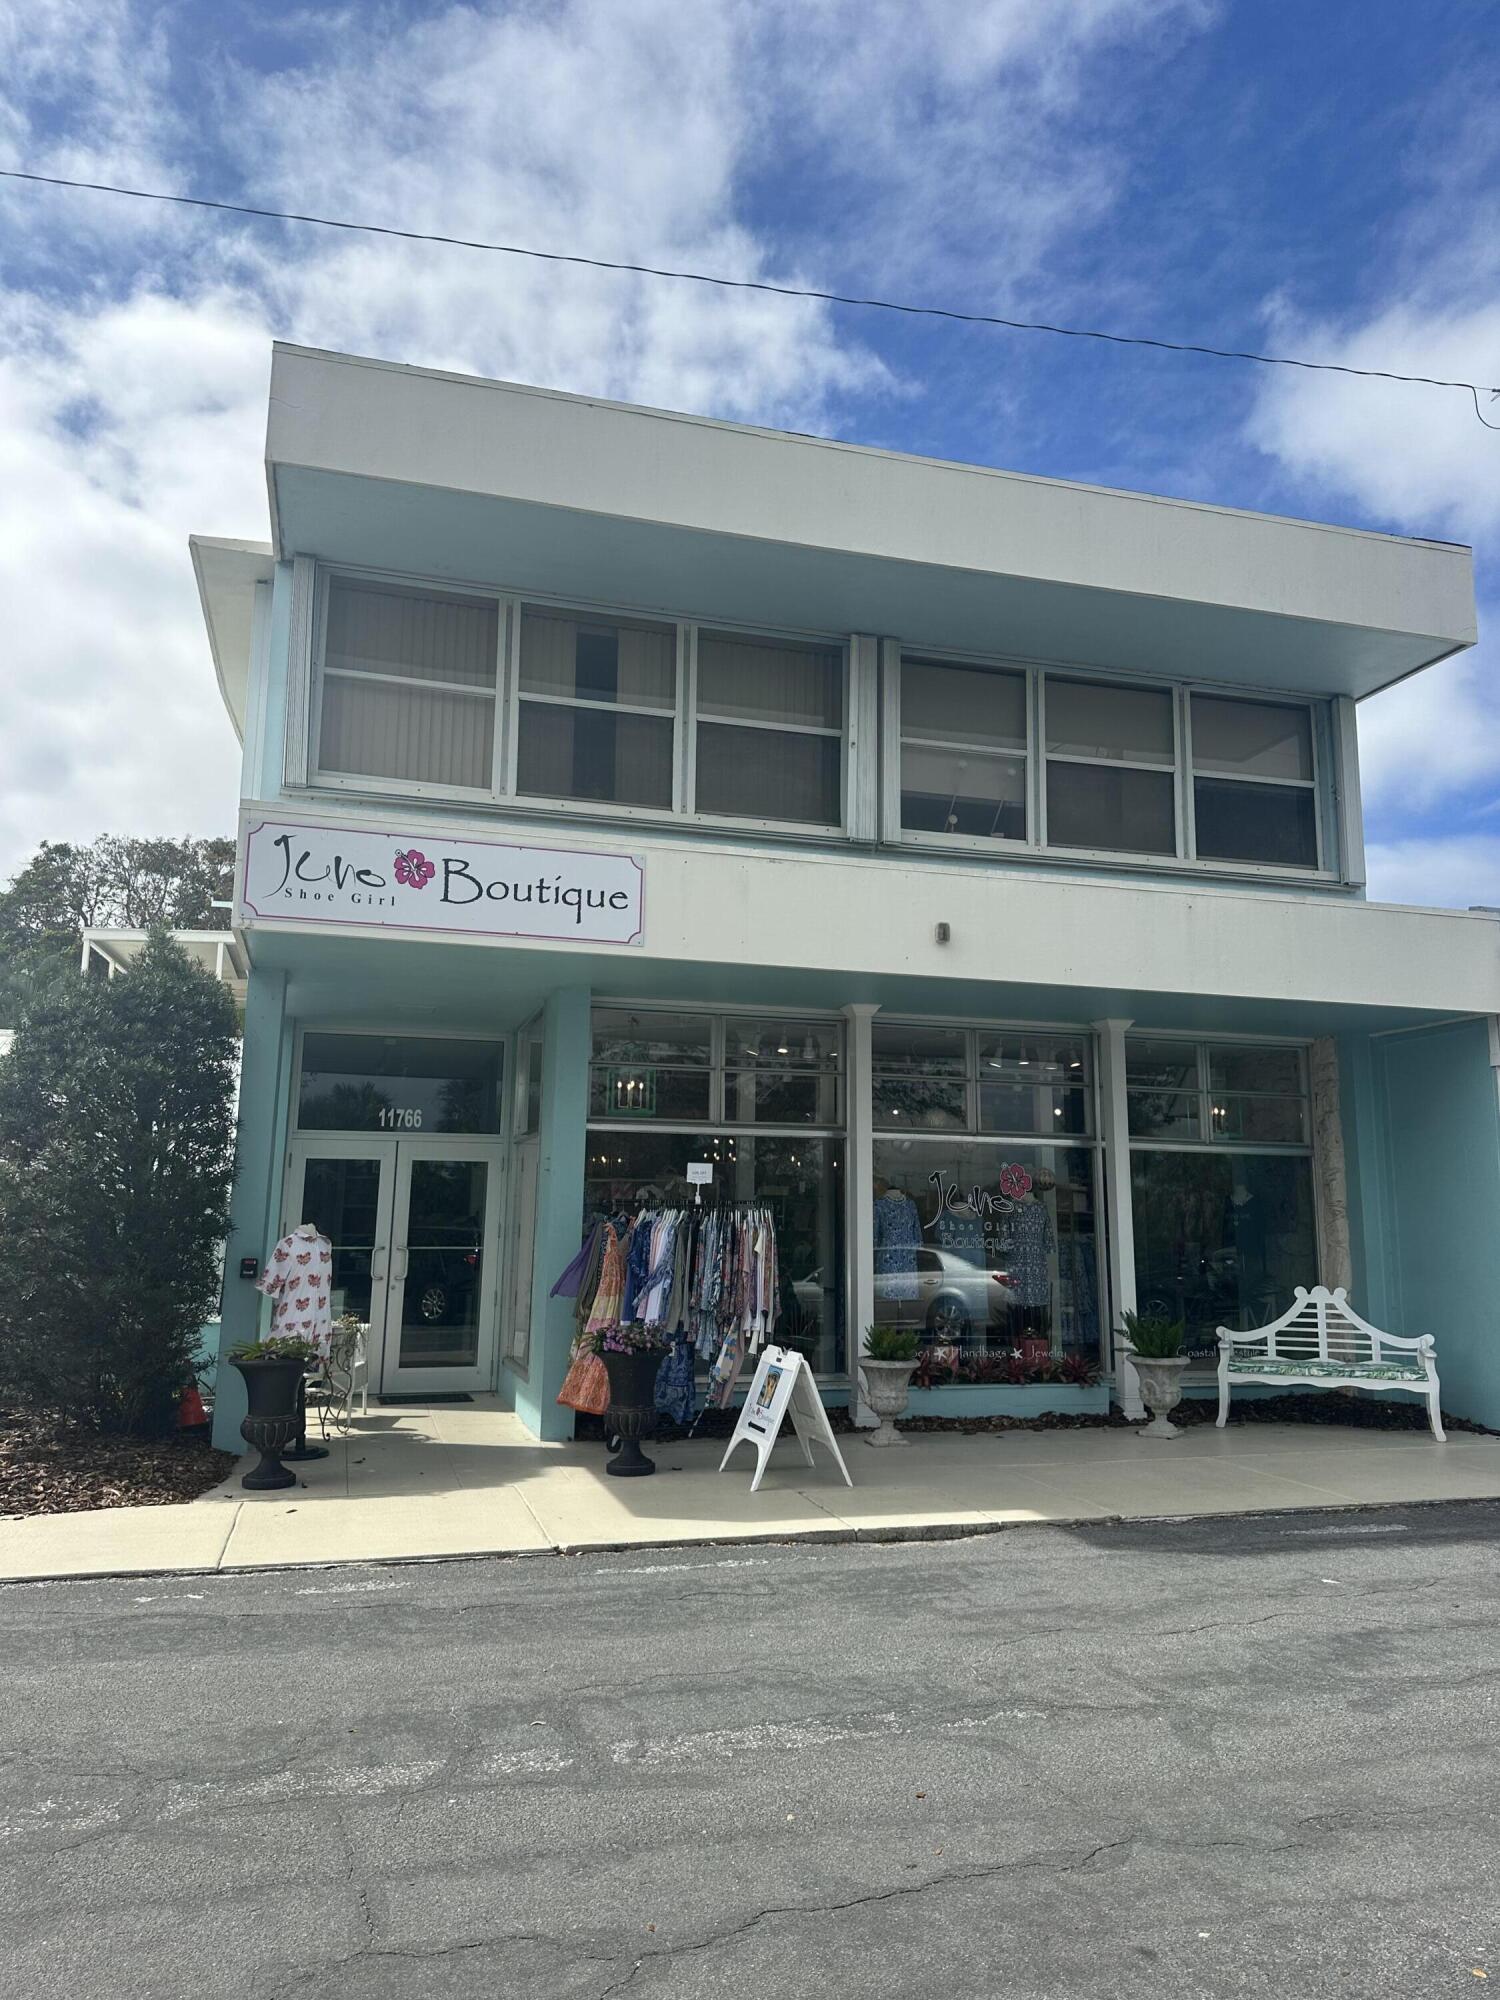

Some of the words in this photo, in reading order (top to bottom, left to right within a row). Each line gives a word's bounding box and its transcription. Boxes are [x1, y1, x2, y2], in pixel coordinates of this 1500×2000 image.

[262, 834, 386, 899] Juno
[440, 858, 629, 924] Boutique
[284, 887, 334, 901] Shoe
[351, 893, 395, 906] Girl
[378, 1108, 422, 1128] 11766
[923, 1170, 1014, 1229] Juno
[939, 1220, 974, 1231] Shoe
[983, 1221, 1015, 1232] Girl
[941, 1233, 1015, 1258] Boutique
[951, 1345, 1006, 1361] Handbags
[1030, 1345, 1067, 1361] Jewelry
[1177, 1345, 1217, 1358] Coastal
